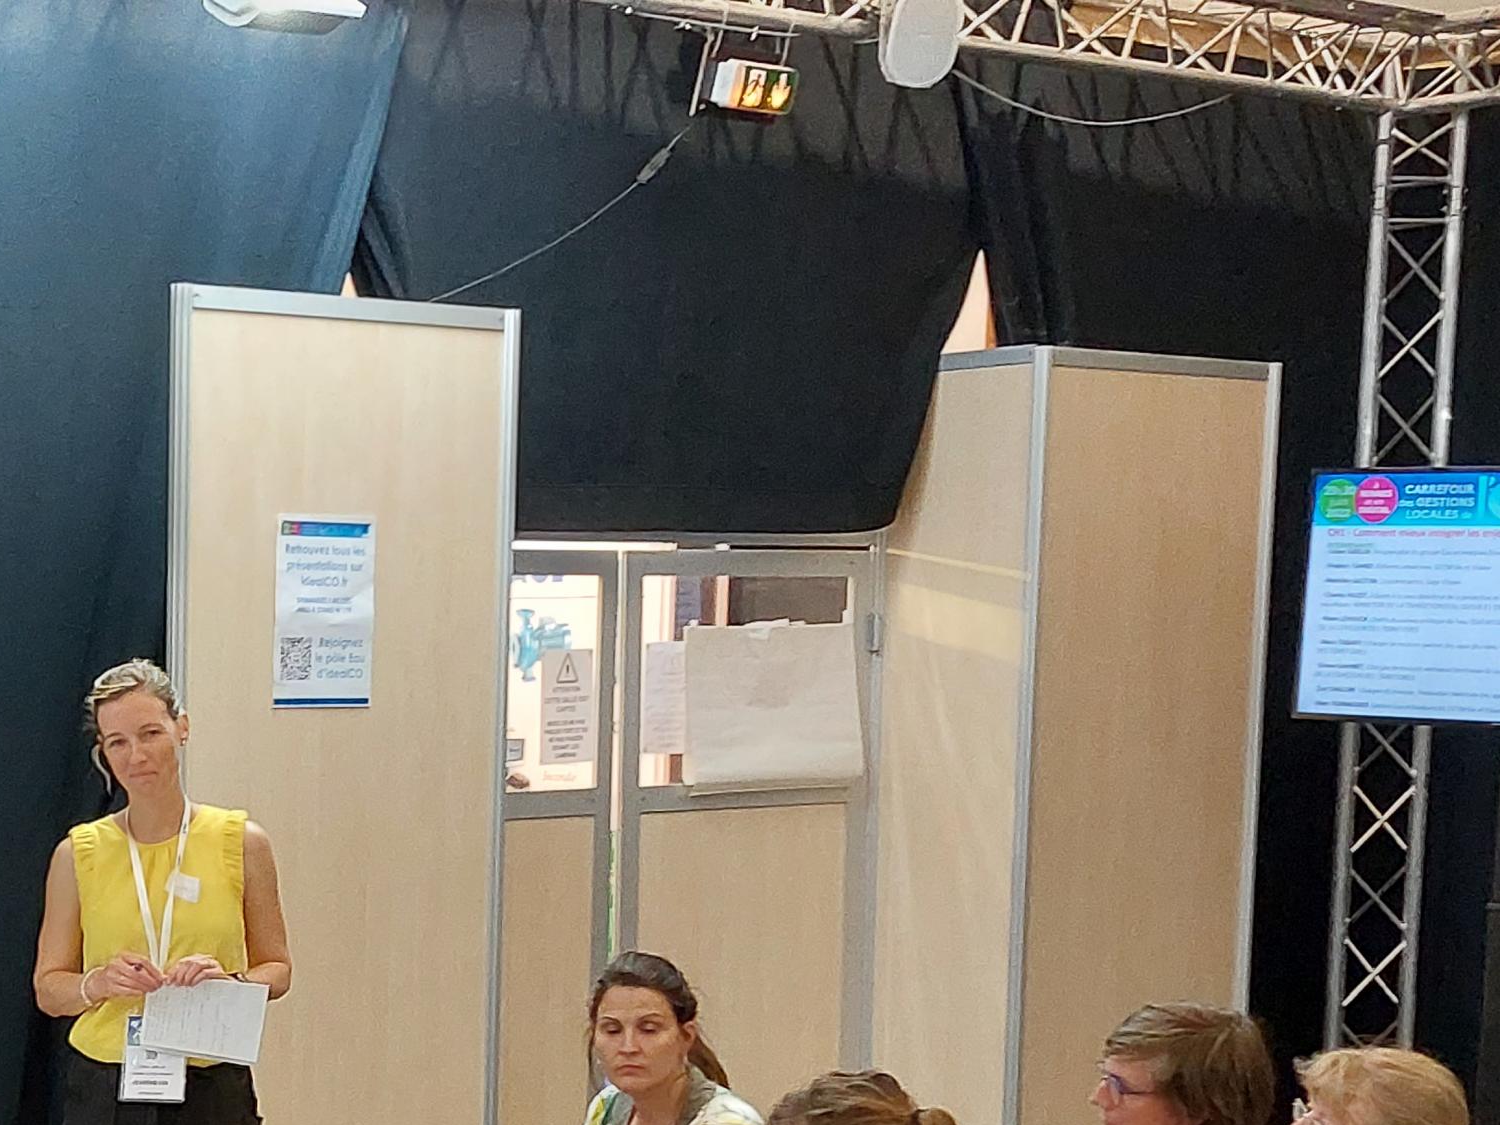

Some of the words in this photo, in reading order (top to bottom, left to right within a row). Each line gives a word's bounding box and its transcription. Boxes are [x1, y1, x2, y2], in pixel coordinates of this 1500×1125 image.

[1404, 483, 1476, 495] CARREFOUR
[1415, 497, 1476, 508] GESTIONS
[1404, 509, 1460, 520] LOCALES
